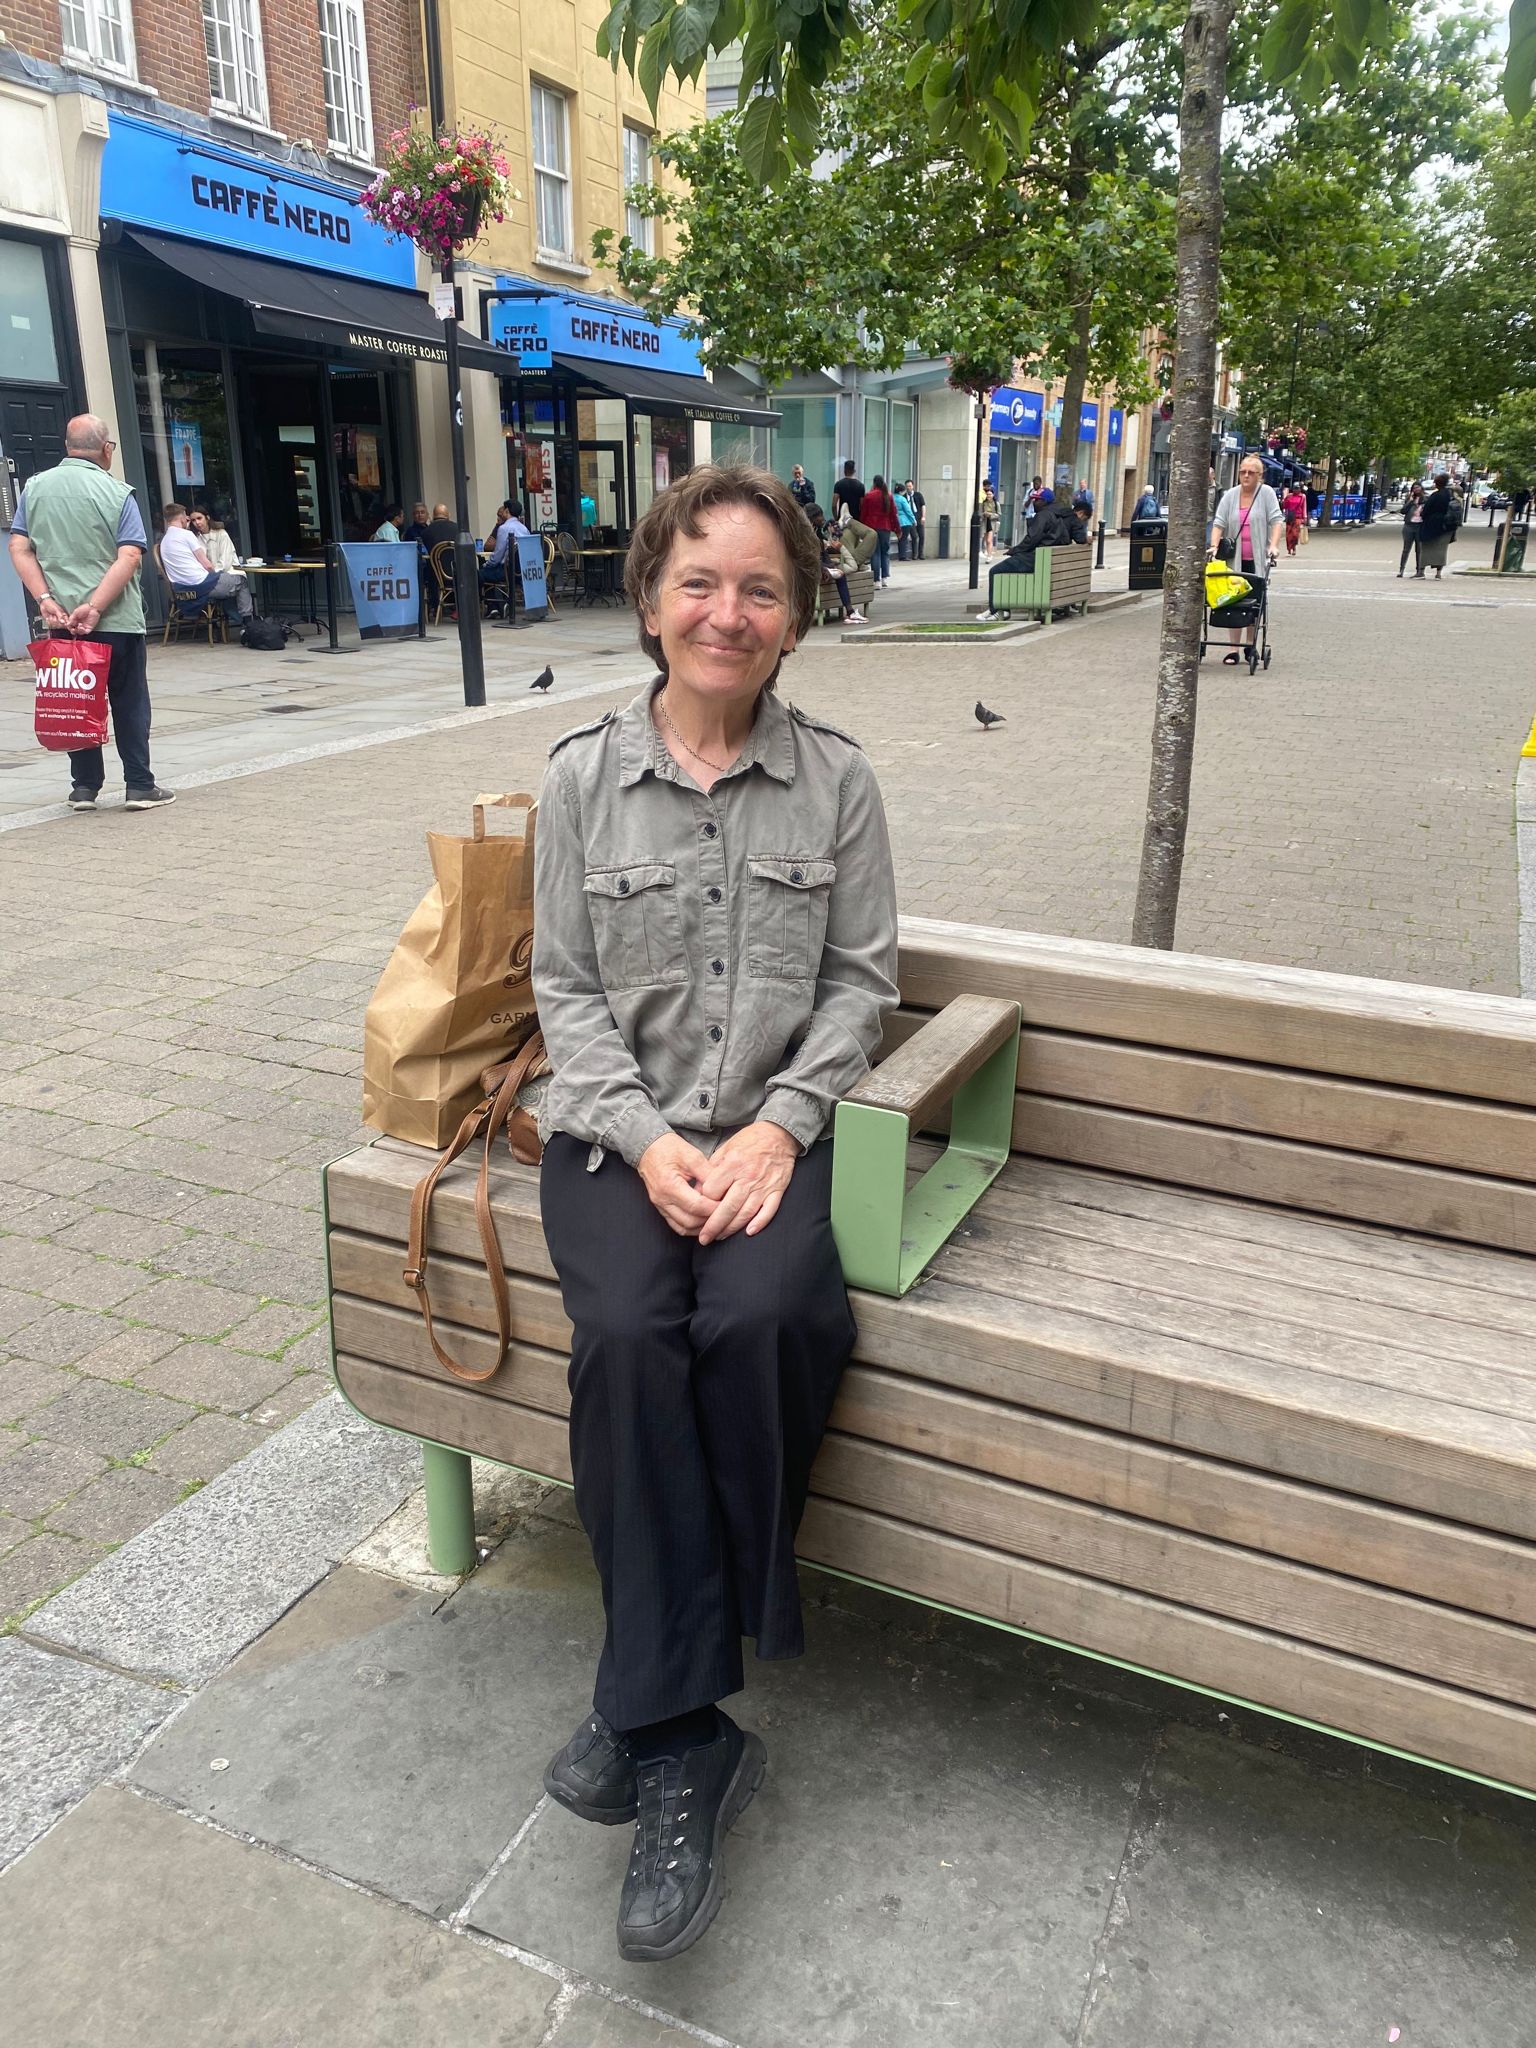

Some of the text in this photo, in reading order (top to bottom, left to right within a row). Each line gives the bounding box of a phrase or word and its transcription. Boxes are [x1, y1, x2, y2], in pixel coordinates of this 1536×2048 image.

[191, 174, 351, 244] CAFFÈ NERO
[504, 322, 538, 334] CAFFÈ
[571, 317, 659, 353] CAFFÈ NERO
[348, 332, 384, 350] MASTER
[386, 340, 417, 357] COFFEE
[495, 338, 548, 352] NERO
[684, 408, 693, 418] THE
[695, 409, 714, 420] ITALIAN
[715, 412, 733, 422] COFFEE
[366, 563, 393, 576] CAFFÈ
[522, 567, 543, 580] NERO
[36, 657, 97, 690] wilko
[43, 691, 69, 699] recycled
[69, 692, 96, 701] material
